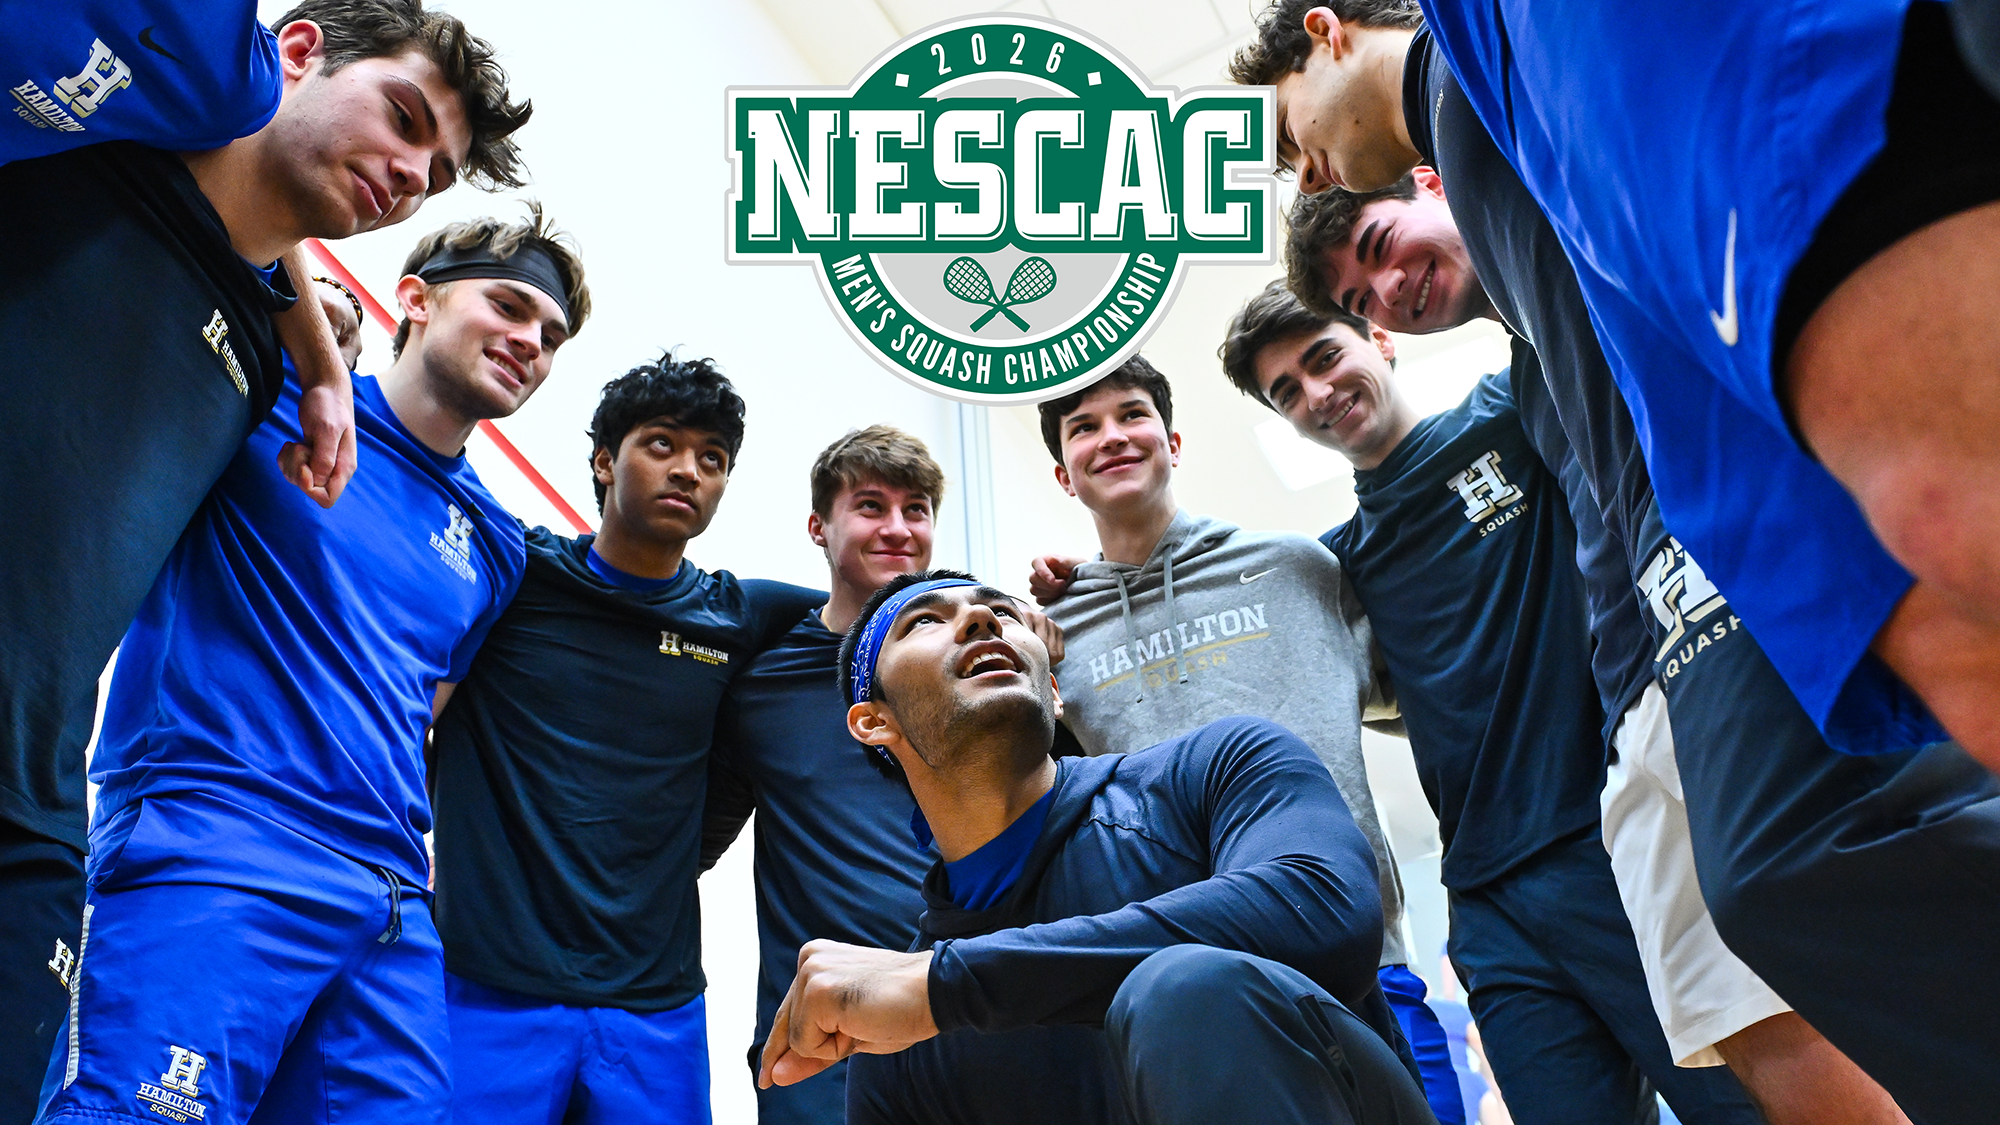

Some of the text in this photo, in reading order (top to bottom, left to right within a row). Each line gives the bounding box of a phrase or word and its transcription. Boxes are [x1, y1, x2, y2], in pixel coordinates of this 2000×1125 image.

[13, 105, 49, 130] SQUASH
[14, 79, 86, 133] HAMILTON
[1479, 502, 1529, 537] SQUASH
[429, 531, 477, 582] HAMILTON
[682, 641, 729, 662] HAMILTON
[1088, 603, 1269, 685] HAMILTON
[1145, 651, 1228, 689] QUASH
[137, 1082, 207, 1118] HAMILTON
[149, 1103, 188, 1123] SQUASH
